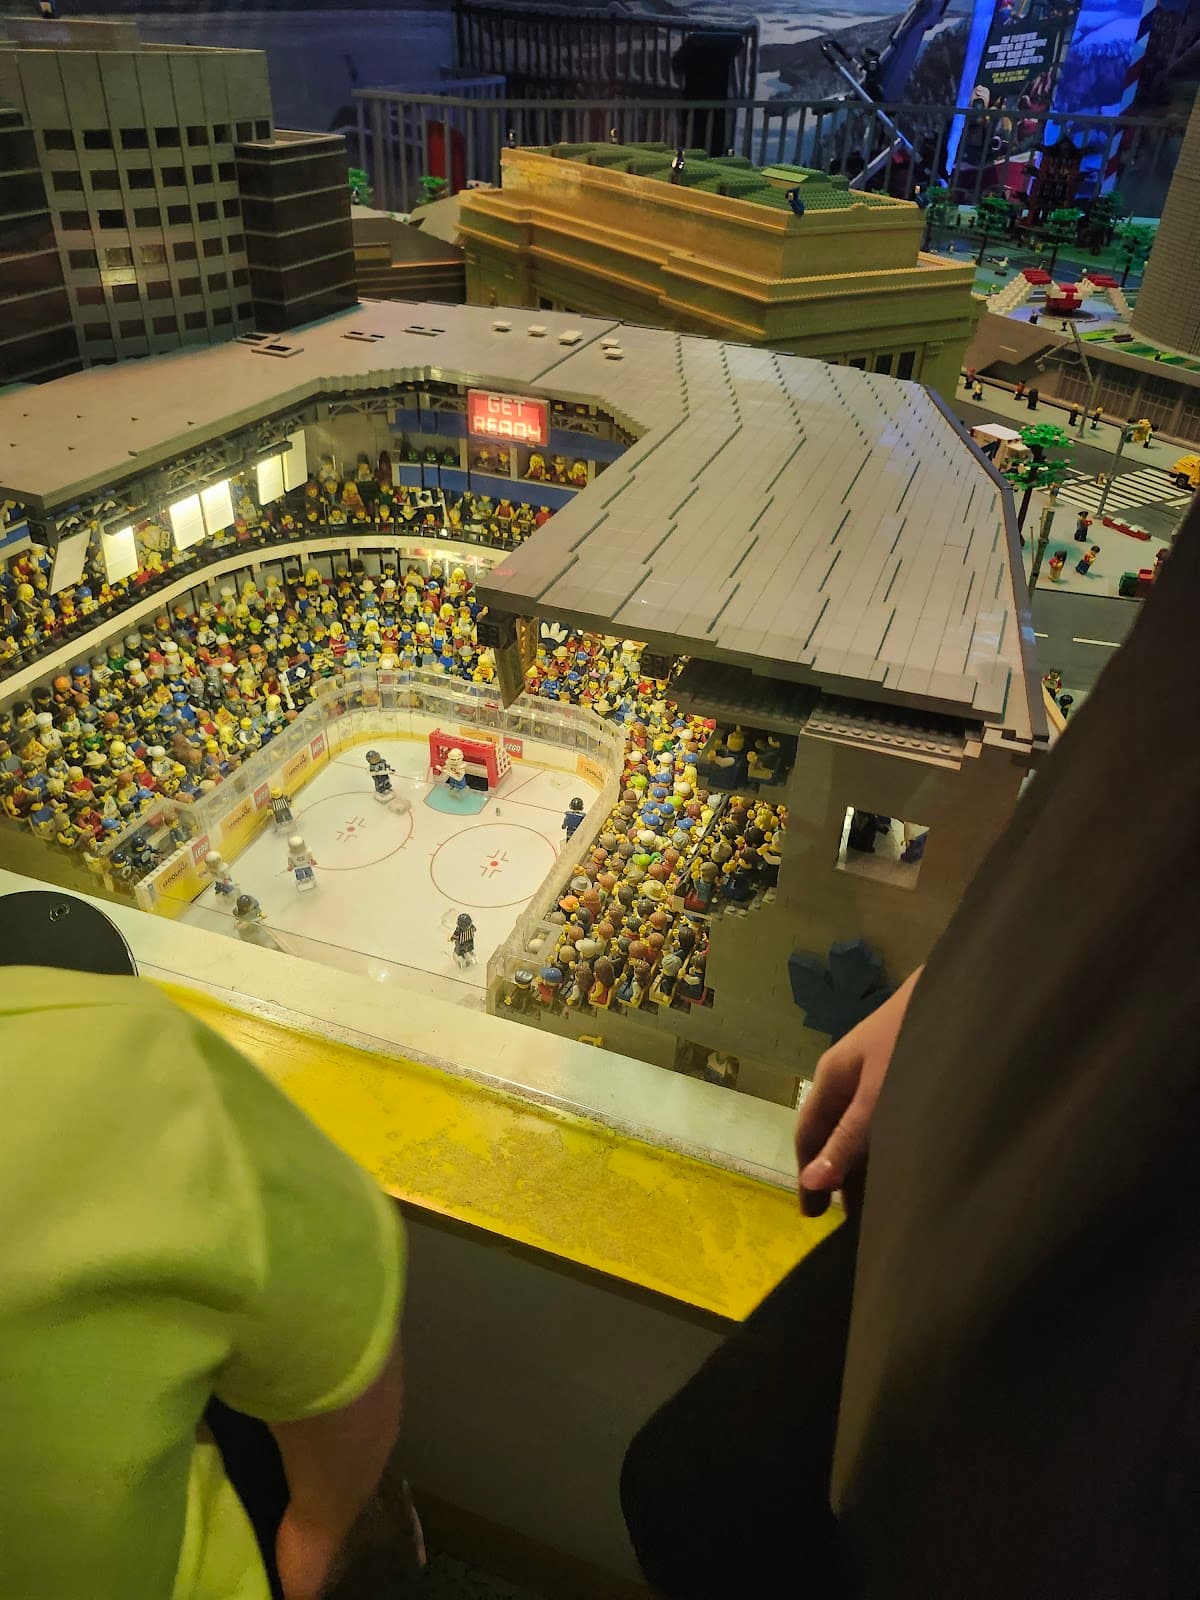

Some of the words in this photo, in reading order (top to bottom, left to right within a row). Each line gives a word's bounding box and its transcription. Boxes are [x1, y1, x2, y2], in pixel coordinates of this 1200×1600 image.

[487, 395, 525, 417] GET
[472, 415, 541, 443] READY
[504, 743, 521, 753] LEGO
